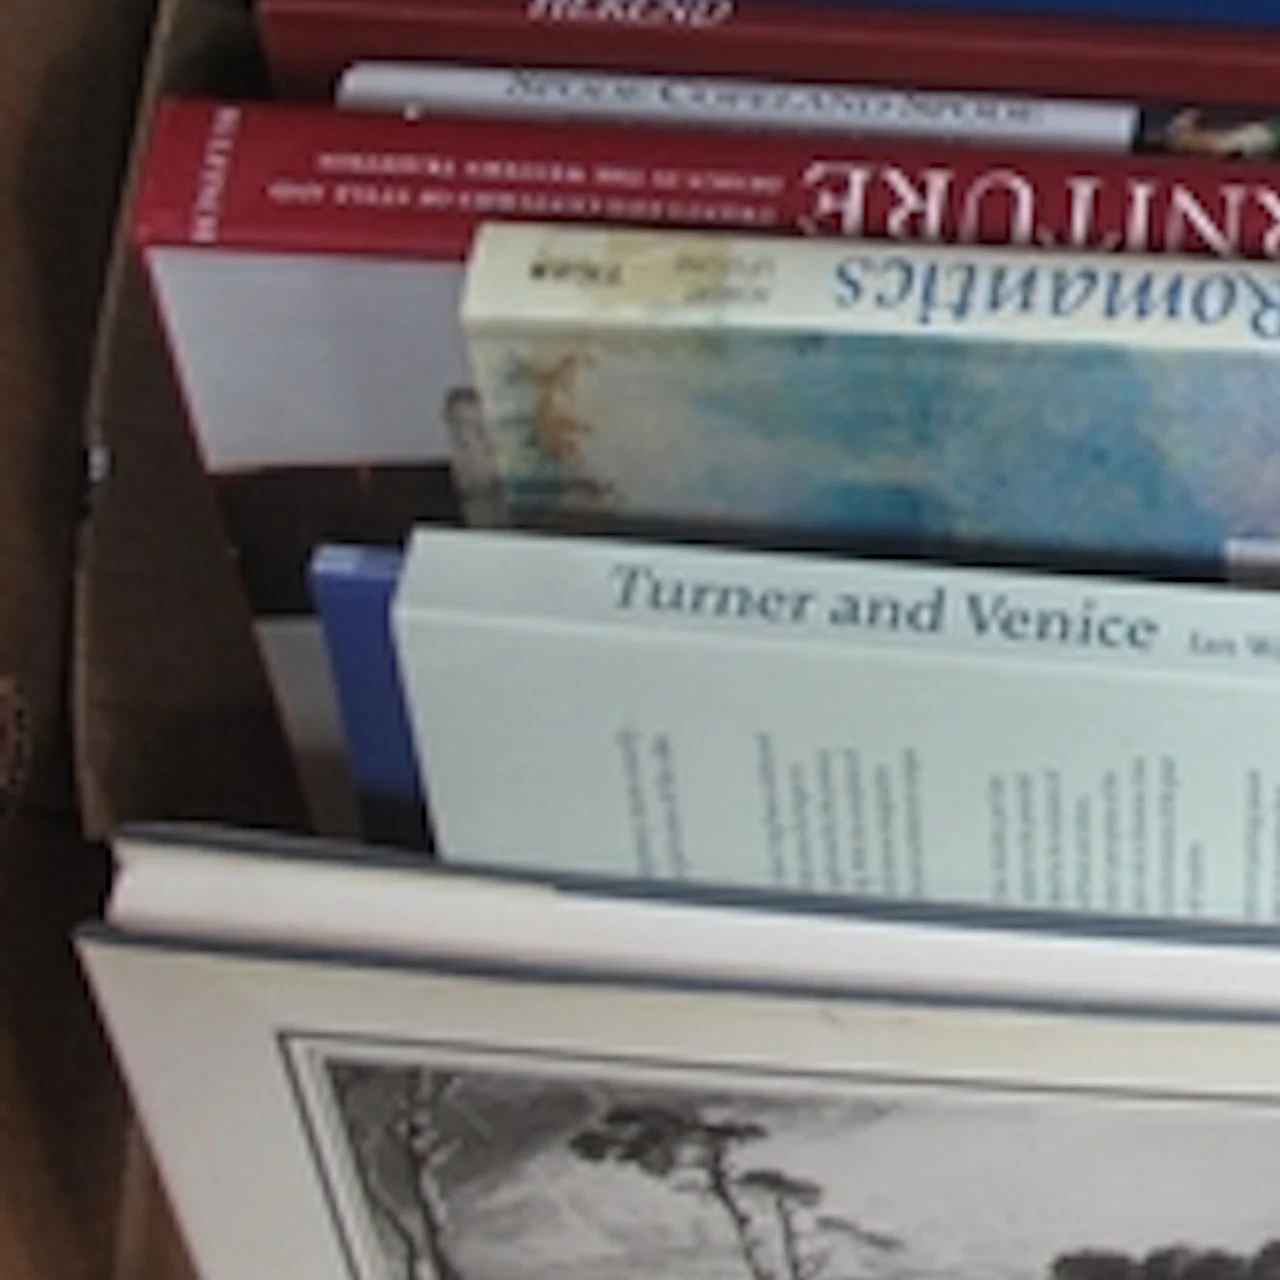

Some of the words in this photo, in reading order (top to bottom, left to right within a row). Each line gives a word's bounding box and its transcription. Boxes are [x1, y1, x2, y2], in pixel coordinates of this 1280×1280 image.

[610, 563, 816, 622] Turner
[828, 587, 946, 634] and
[966, 593, 1160, 651] Venice
[1187, 630, 1236, 659] Ian
